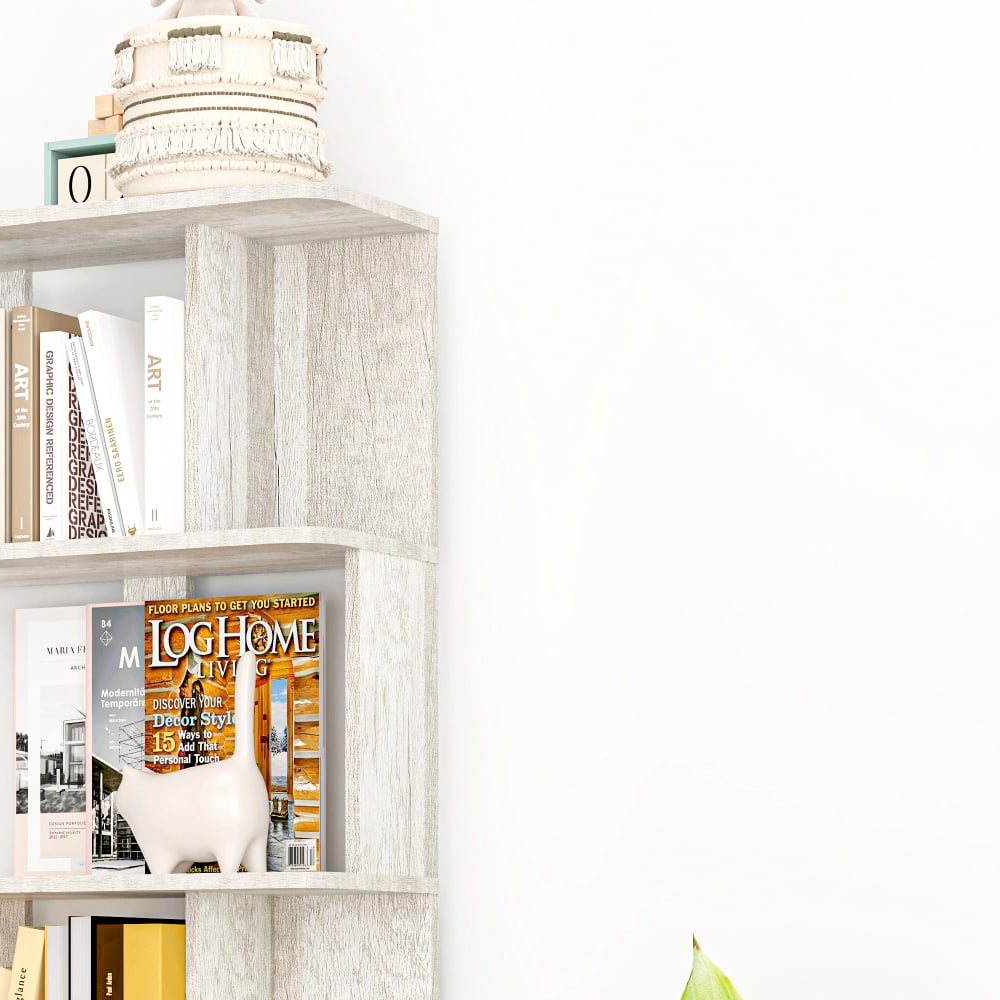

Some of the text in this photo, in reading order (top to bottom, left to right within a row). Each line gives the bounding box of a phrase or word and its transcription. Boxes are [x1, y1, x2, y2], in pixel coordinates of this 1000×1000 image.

[14, 363, 29, 400] ART
[147, 354, 162, 391] ART
[46, 350, 54, 505] GRAPHIC DESIGN REFERENCED
[85, 418, 104, 473] BORDEAUX
[104, 417, 125, 483] EERO SAARINEN
[148, 597, 316, 615] FLOOR PLANS TO GET YOU STARTED
[101, 620, 112, 628] B4
[46, 646, 75, 655] MARIA
[199, 658, 269, 679] LIVIG
[153, 694, 223, 710] DISCOVER YOUR
[152, 713, 197, 728] Decor
[152, 731, 176, 753] 15
[177, 729, 213, 741] Ways to
[178, 741, 218, 752] Add That
[153, 753, 220, 765] Personal Touch
